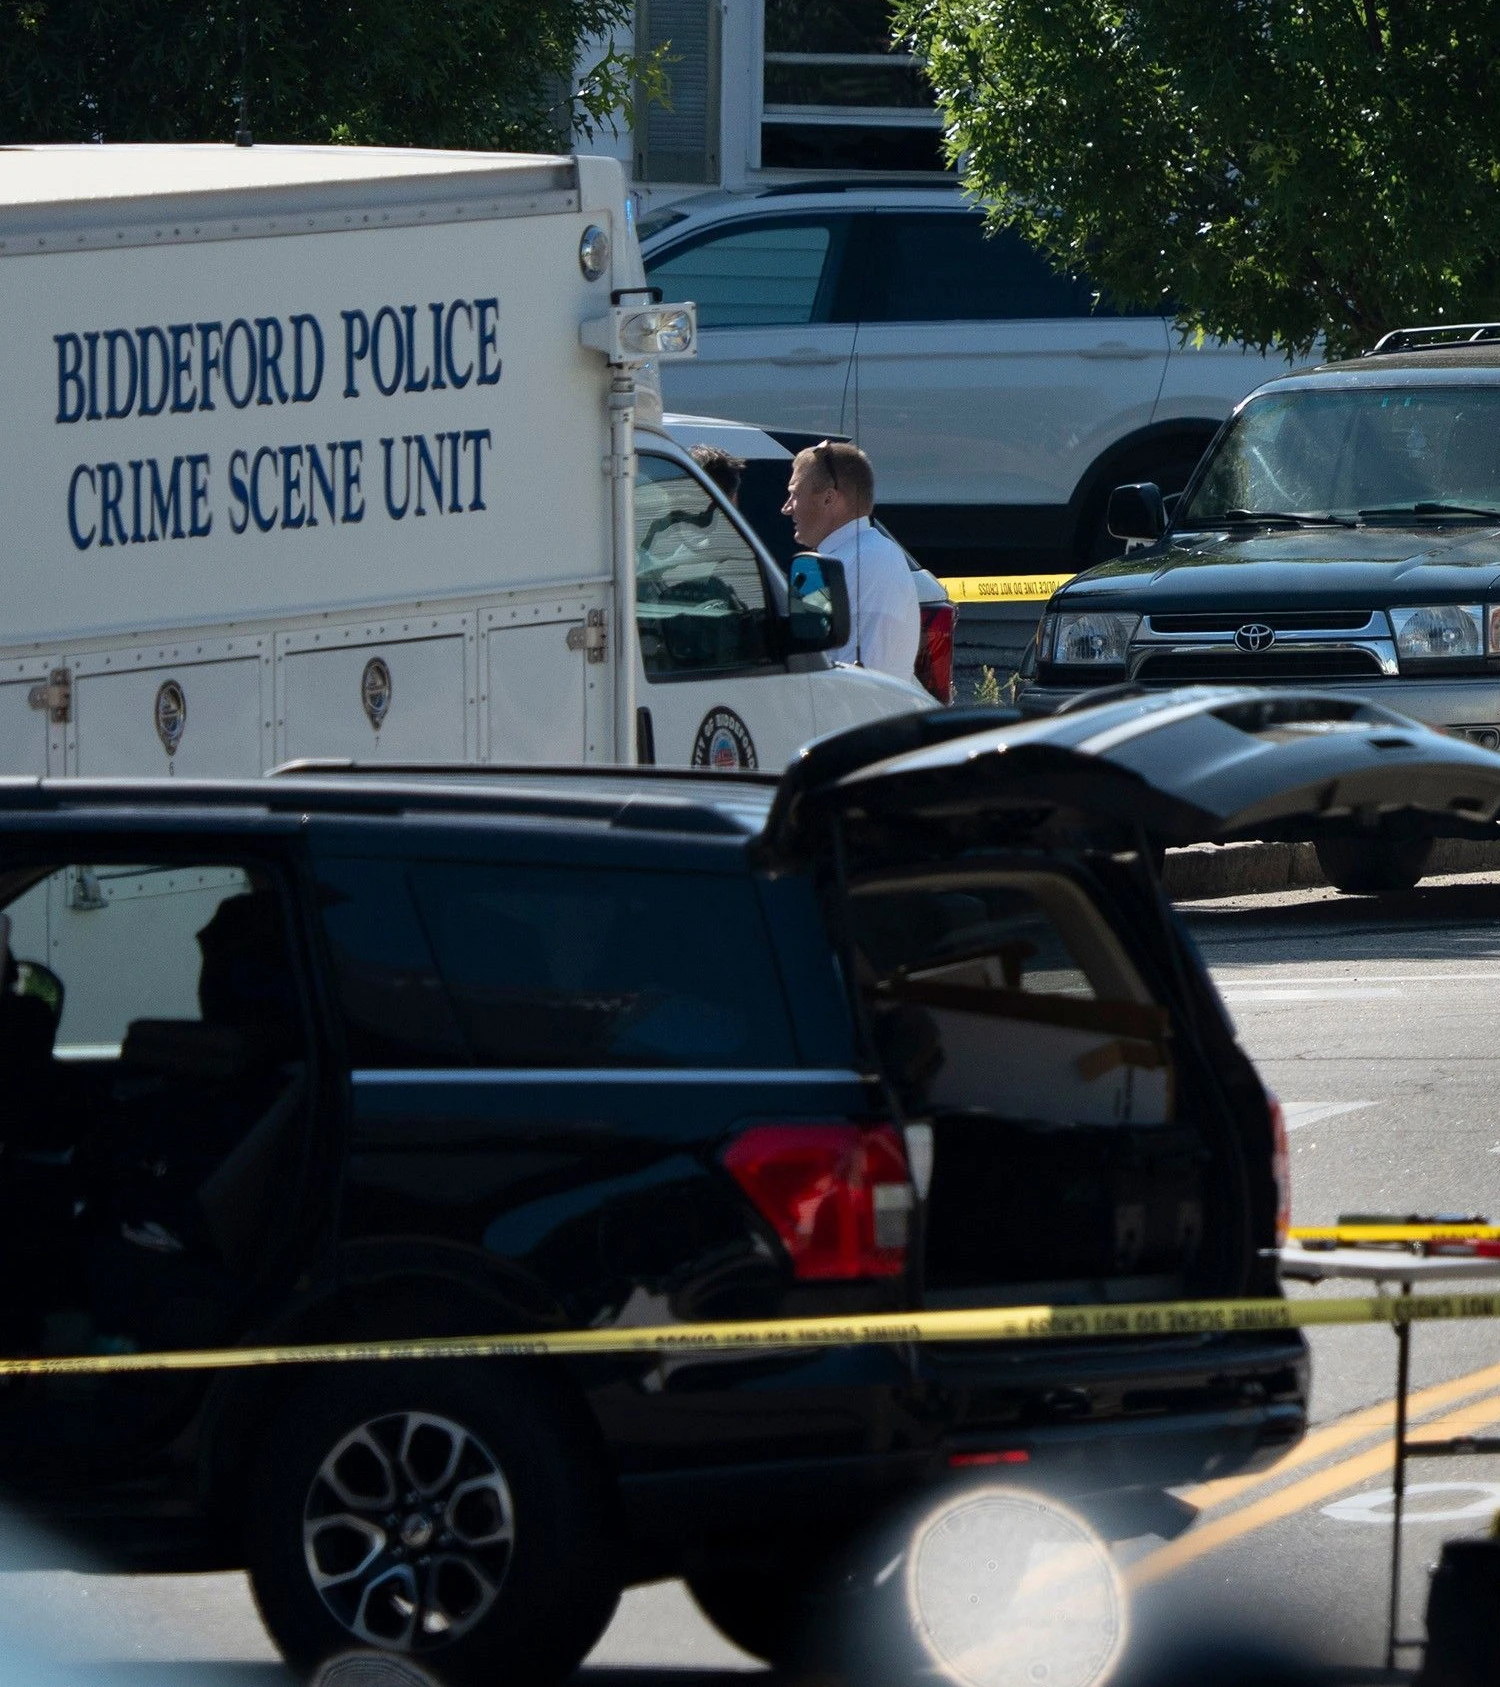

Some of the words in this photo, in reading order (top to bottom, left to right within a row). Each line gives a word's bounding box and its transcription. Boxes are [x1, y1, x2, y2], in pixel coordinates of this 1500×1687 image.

[53, 314, 324, 424] BIDDEFORD
[341, 298, 501, 398] POLICE
[67, 454, 212, 550] CRIME
[229, 440, 365, 534] SCENE
[380, 429, 491, 520] UNIT
[978, 583, 999, 596] CROSS
[1001, 582, 1013, 596] NOT
[1013, 582, 1024, 596] DO
[1024, 581, 1039, 596] LINE
